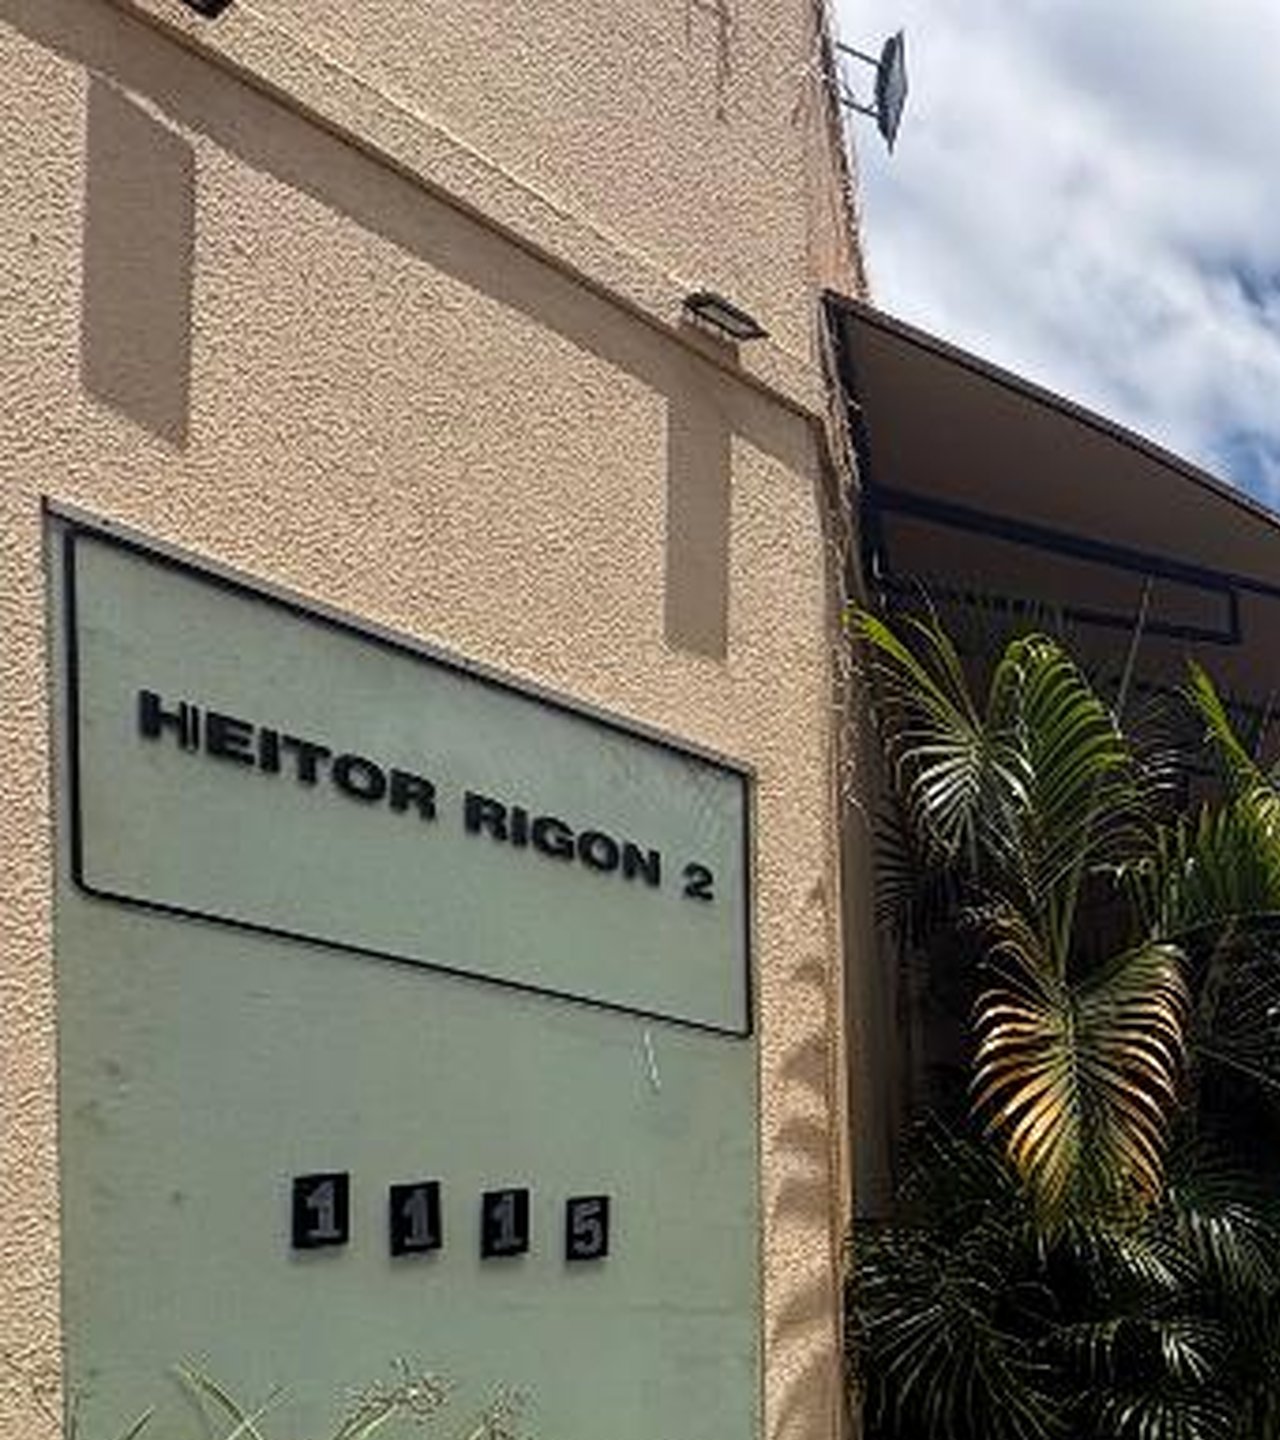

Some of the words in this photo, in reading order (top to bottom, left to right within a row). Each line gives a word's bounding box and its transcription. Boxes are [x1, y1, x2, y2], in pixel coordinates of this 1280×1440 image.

[139, 689, 437, 821] HEITOR
[463, 790, 661, 889] RIGON
[683, 862, 714, 901] 2
